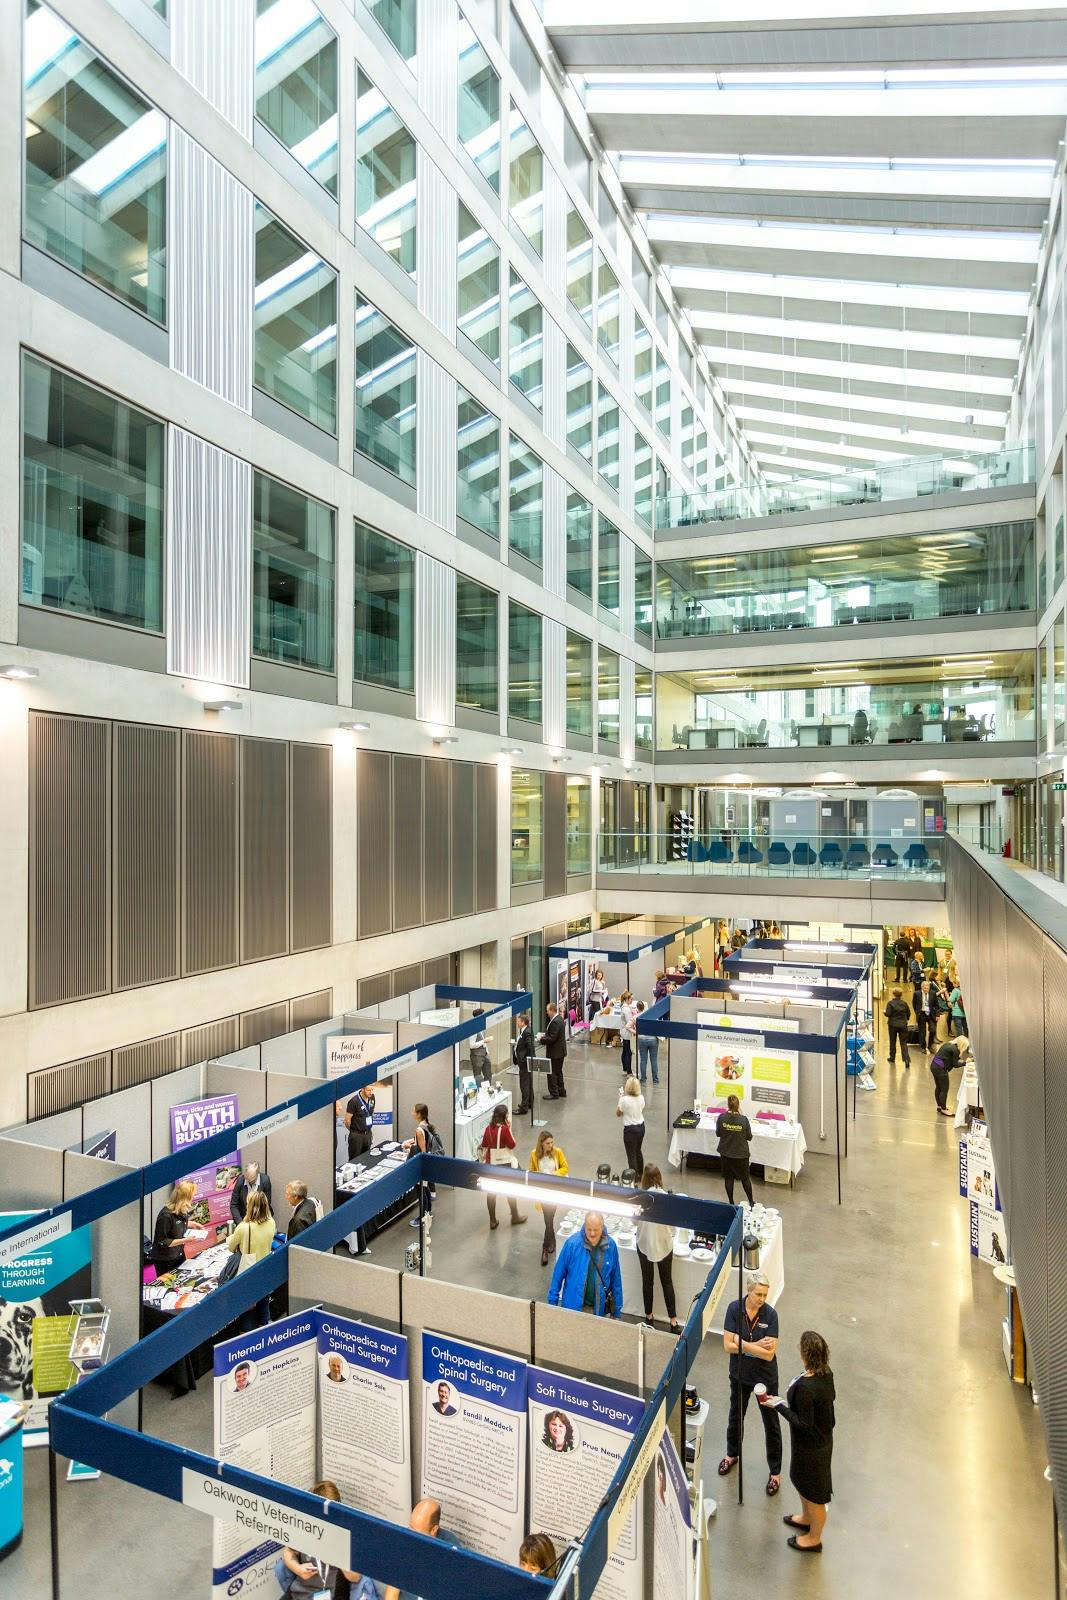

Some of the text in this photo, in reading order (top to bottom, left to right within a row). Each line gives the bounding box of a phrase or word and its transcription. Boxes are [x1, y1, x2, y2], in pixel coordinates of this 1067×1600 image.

[357, 1039, 366, 1052] of
[741, 1036, 758, 1044] Health
[331, 1051, 361, 1063] Happiness
[215, 1100, 234, 1108] worms
[174, 1105, 235, 1133] MYTH
[260, 1121, 275, 1134] Animal
[968, 1149, 987, 1161] SUSTAIN
[960, 1145, 968, 1189] SUSTAIN
[979, 1209, 999, 1222] SUSTAIN
[970, 1205, 979, 1249] SUSTAIN
[9, 1222, 60, 1253] International
[2, 1268, 45, 1278] THROUGH
[2, 1277, 46, 1288] LEARNING
[228, 1322, 311, 1363] Internal Medicine
[322, 1323, 397, 1355] Orthopaedics and
[329, 1337, 391, 1368] Spinal Surgery
[260, 1356, 300, 1377] Ian Hopkins
[431, 1346, 516, 1382] Orthopaedics and
[352, 1374, 373, 1386] Charlie
[438, 1363, 507, 1397] Spinal Surgery
[536, 1382, 634, 1426] Soft Tissue Surgery
[484, 1416, 514, 1433] Maddock
[582, 1440, 599, 1451] Prue
[203, 1480, 325, 1540] Oakwood Veterinary
[235, 1510, 290, 1543] Referrals
[540, 1530, 567, 1542] COMMON
